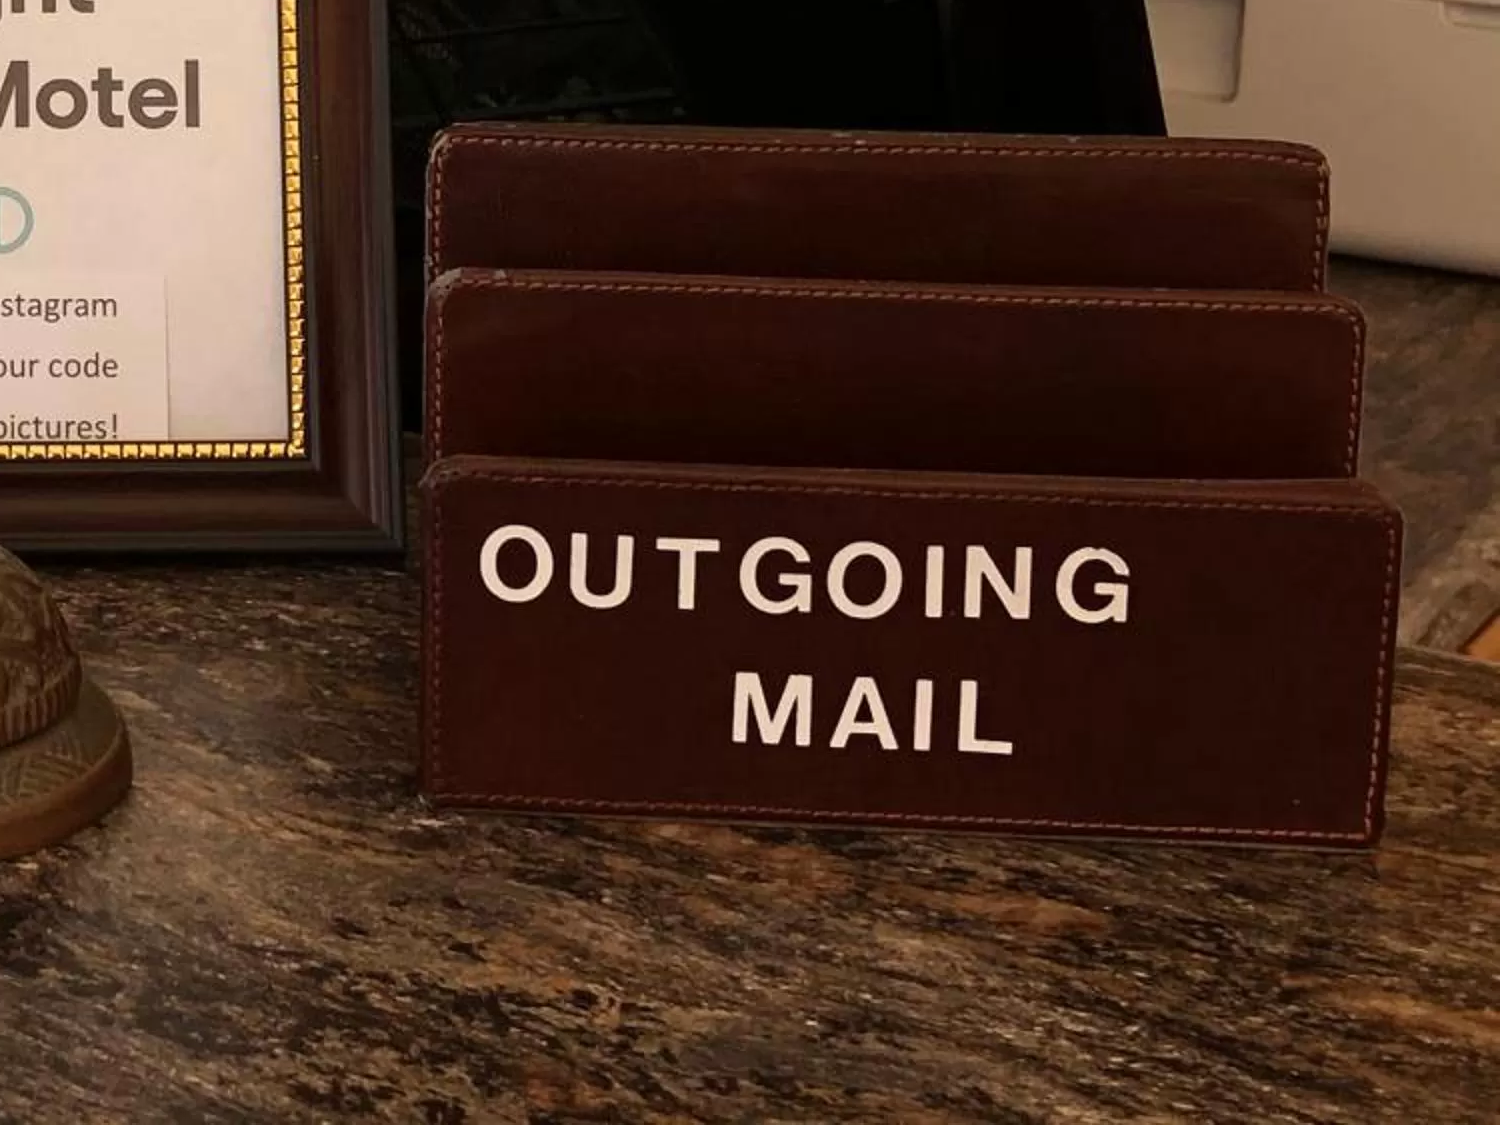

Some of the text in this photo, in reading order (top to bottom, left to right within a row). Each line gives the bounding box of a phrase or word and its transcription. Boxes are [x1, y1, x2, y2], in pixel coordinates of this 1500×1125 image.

[49, 352, 118, 378] code
[480, 525, 1129, 623] OUTGOING
[733, 672, 1012, 754] MAIL
